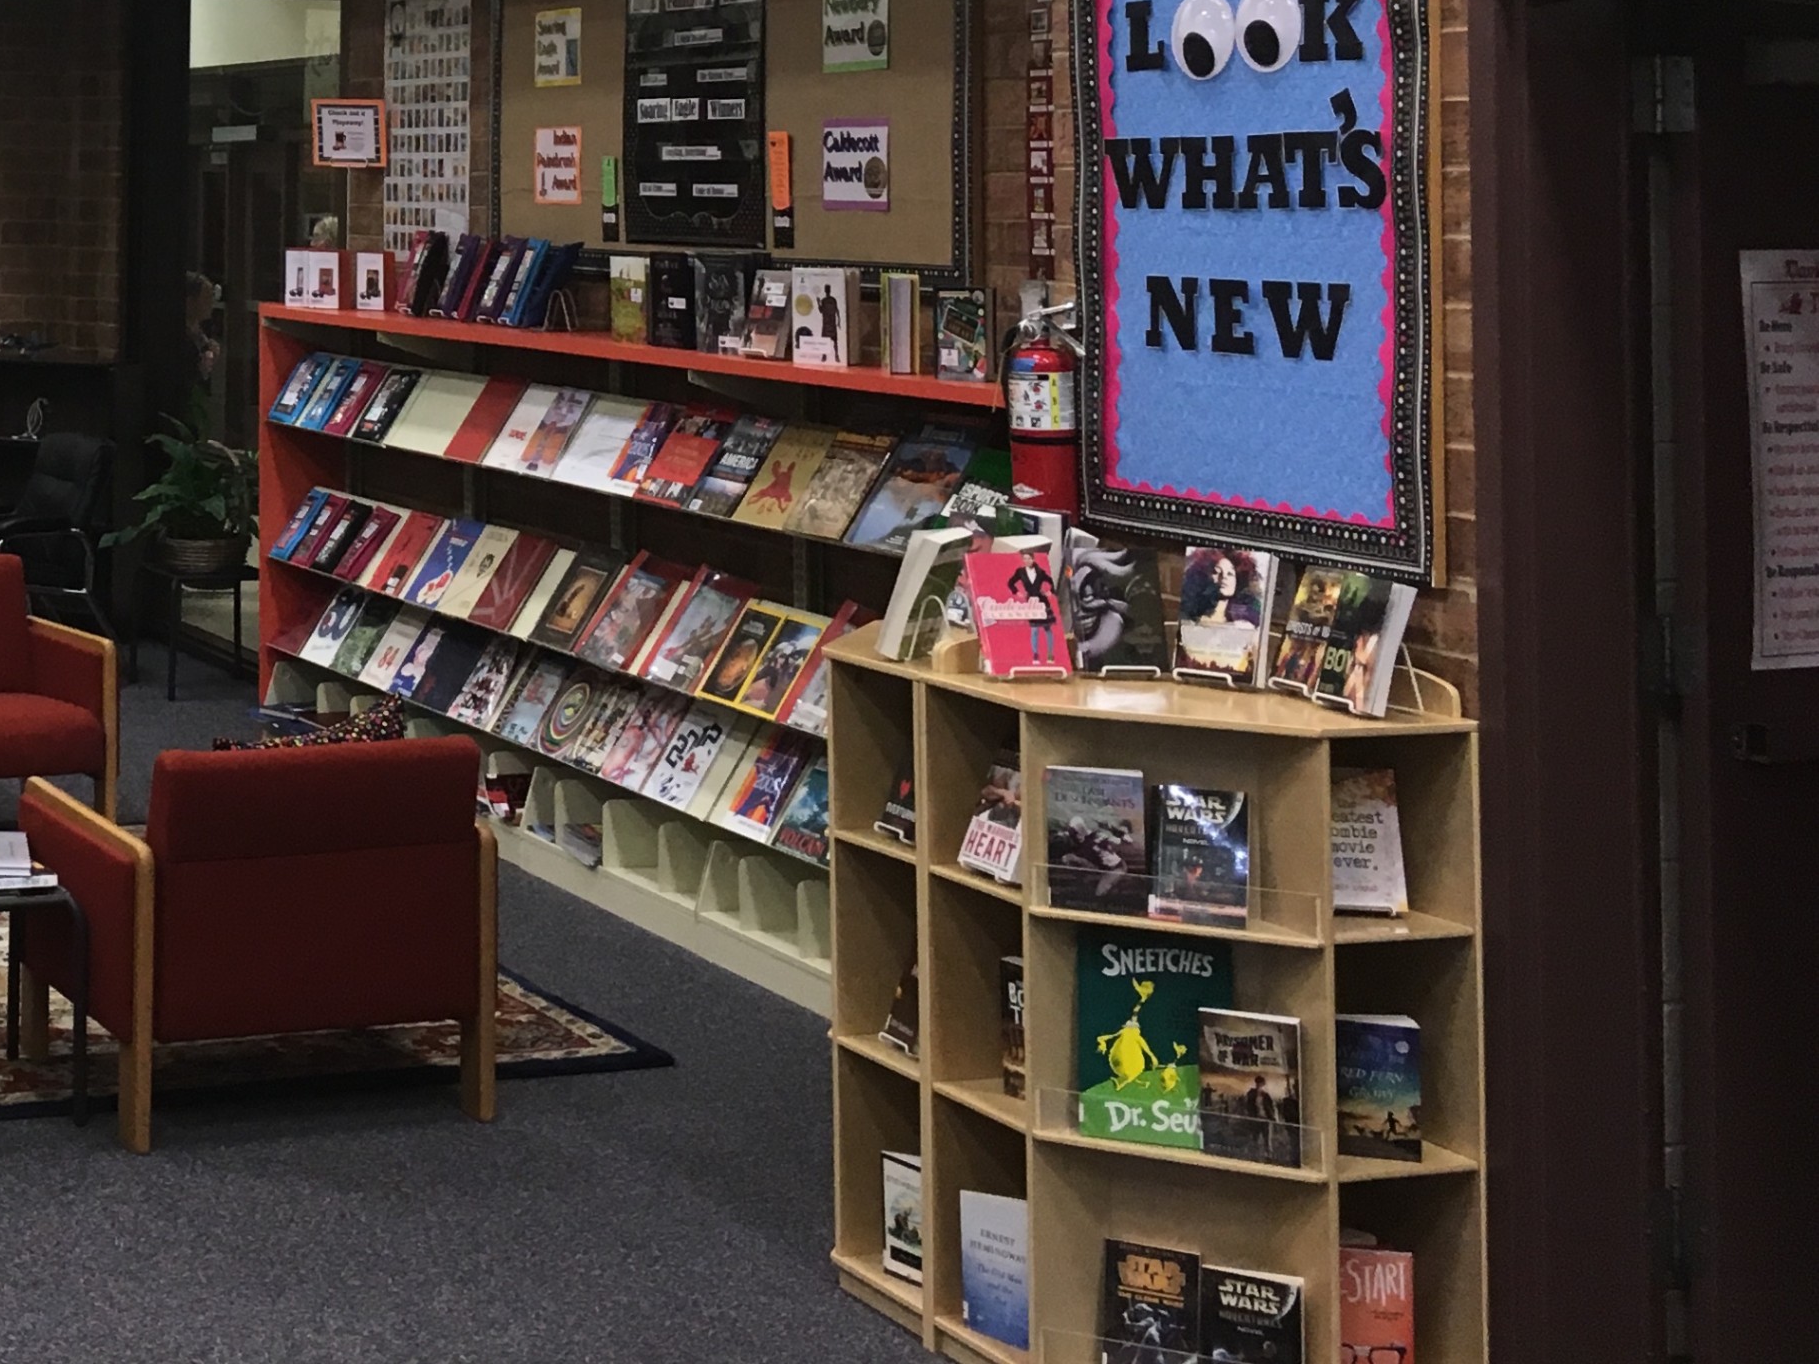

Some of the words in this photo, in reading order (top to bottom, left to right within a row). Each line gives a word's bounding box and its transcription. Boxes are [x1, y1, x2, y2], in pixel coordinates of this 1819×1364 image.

[1104, 88, 1387, 210] WHAT'S
[1145, 275, 1351, 361] NEW
[965, 830, 1017, 867] HEART
[1333, 857, 1378, 871] ever.
[1101, 943, 1214, 977] SNEETCHES
[1104, 1101, 1147, 1132] Dr.
[1218, 1278, 1280, 1301] STAR
[1219, 1292, 1280, 1315] WARS
